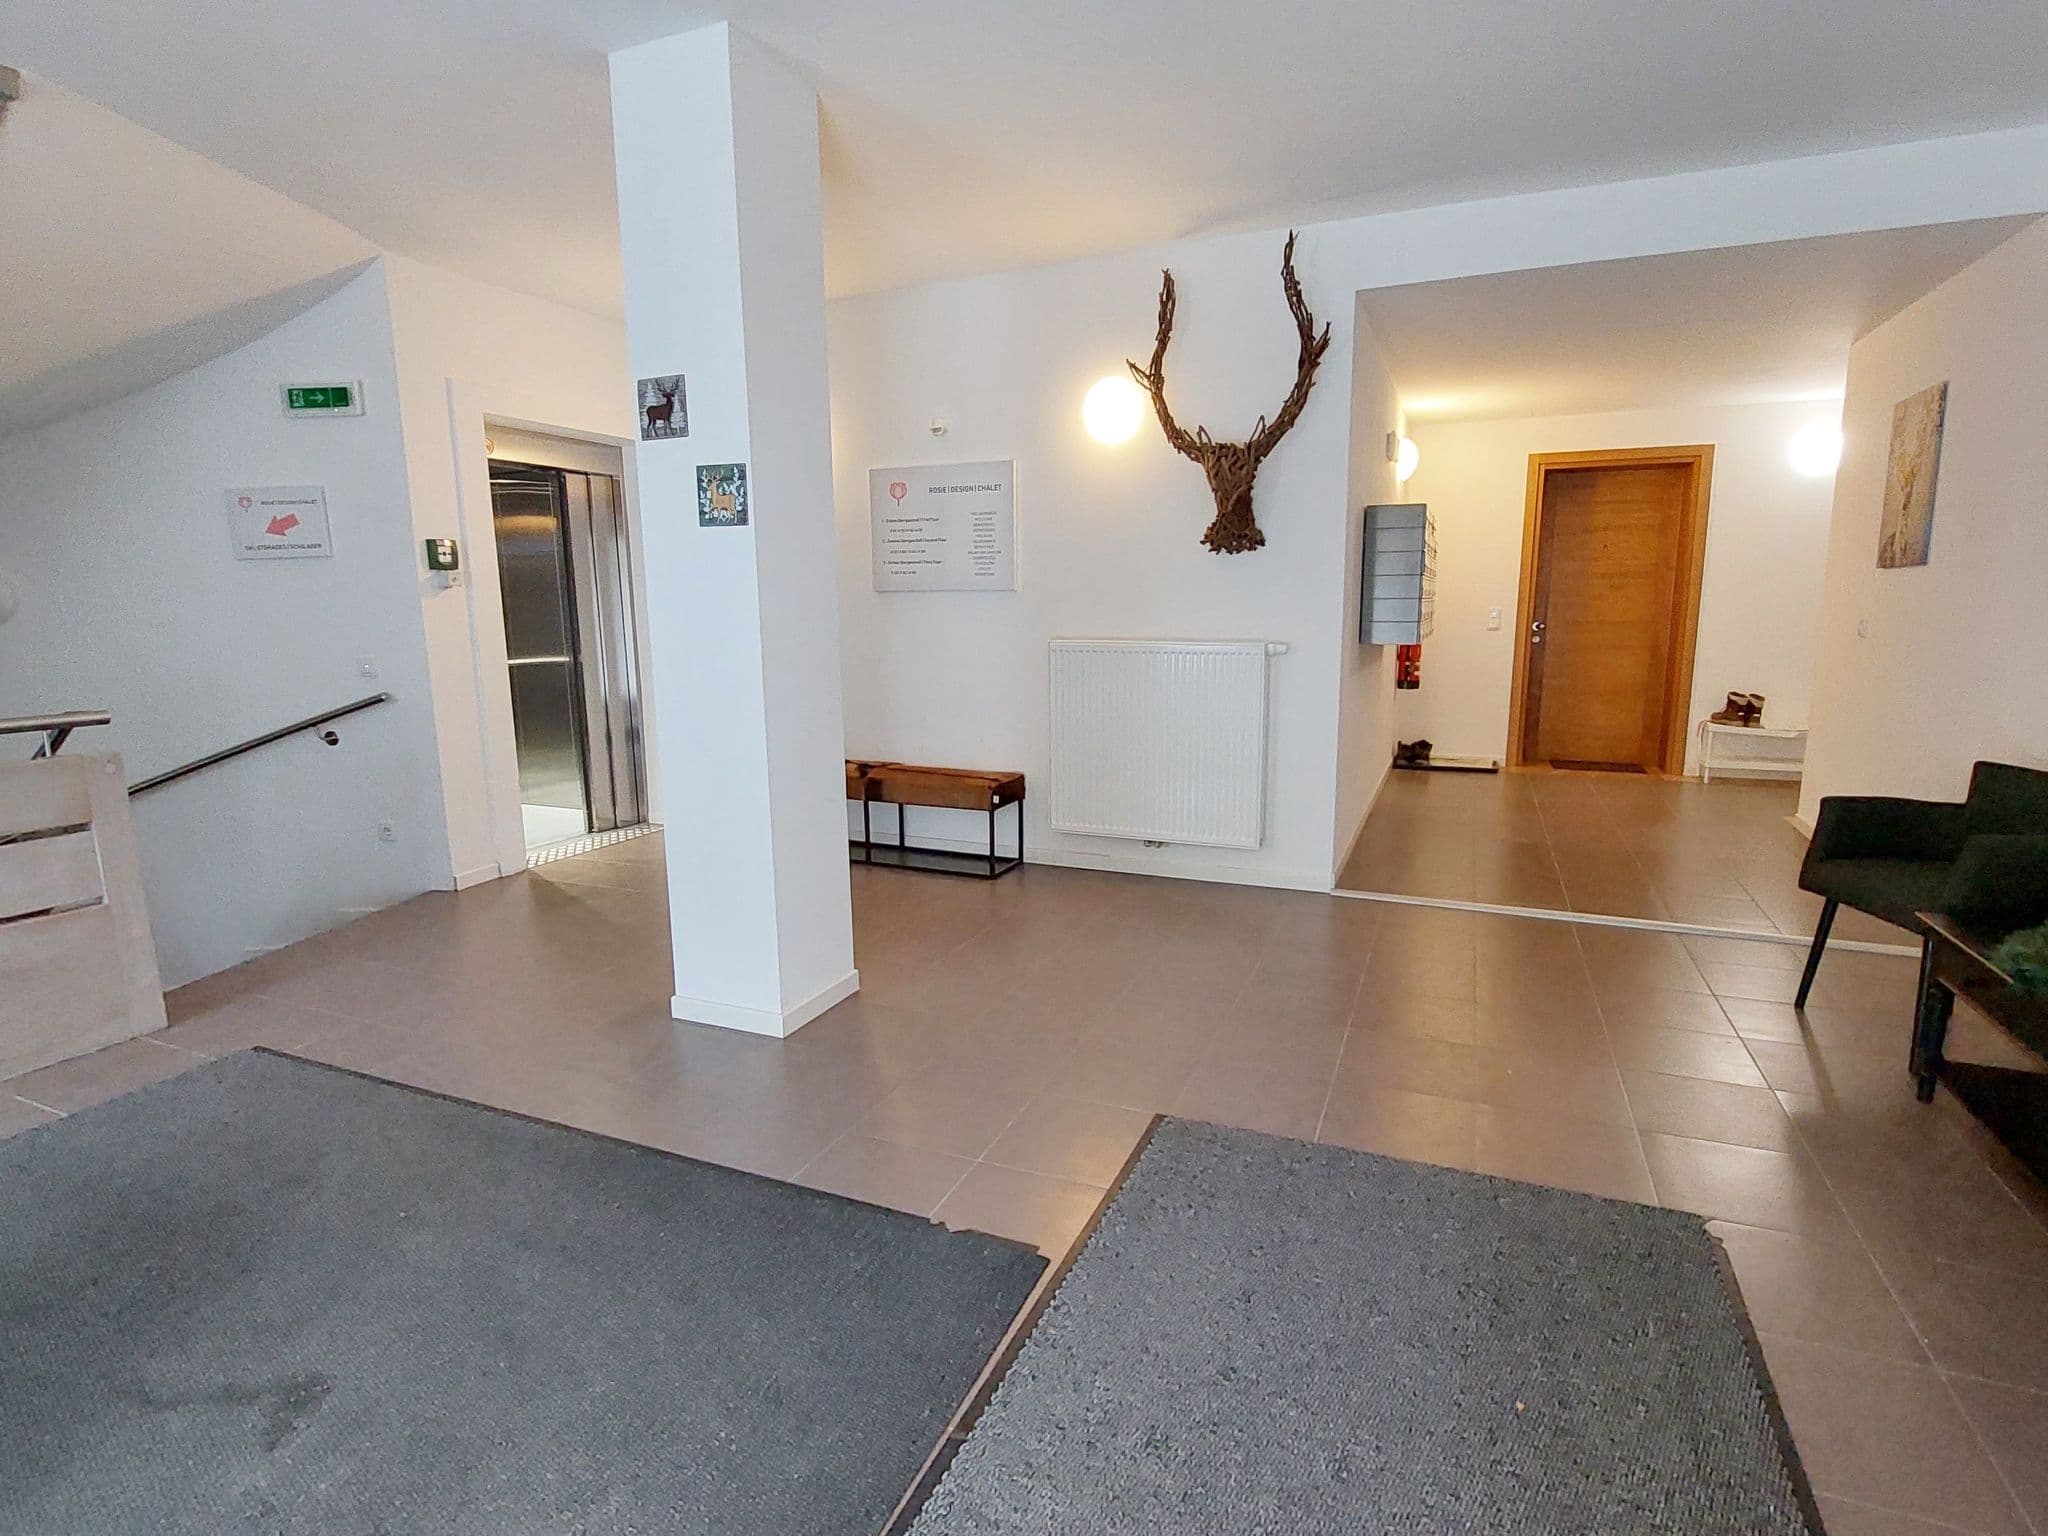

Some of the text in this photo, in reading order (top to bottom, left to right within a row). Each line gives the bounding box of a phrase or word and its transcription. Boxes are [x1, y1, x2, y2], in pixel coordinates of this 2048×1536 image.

[928, 483, 1002, 494] ROSIE DESIGN CHALET
